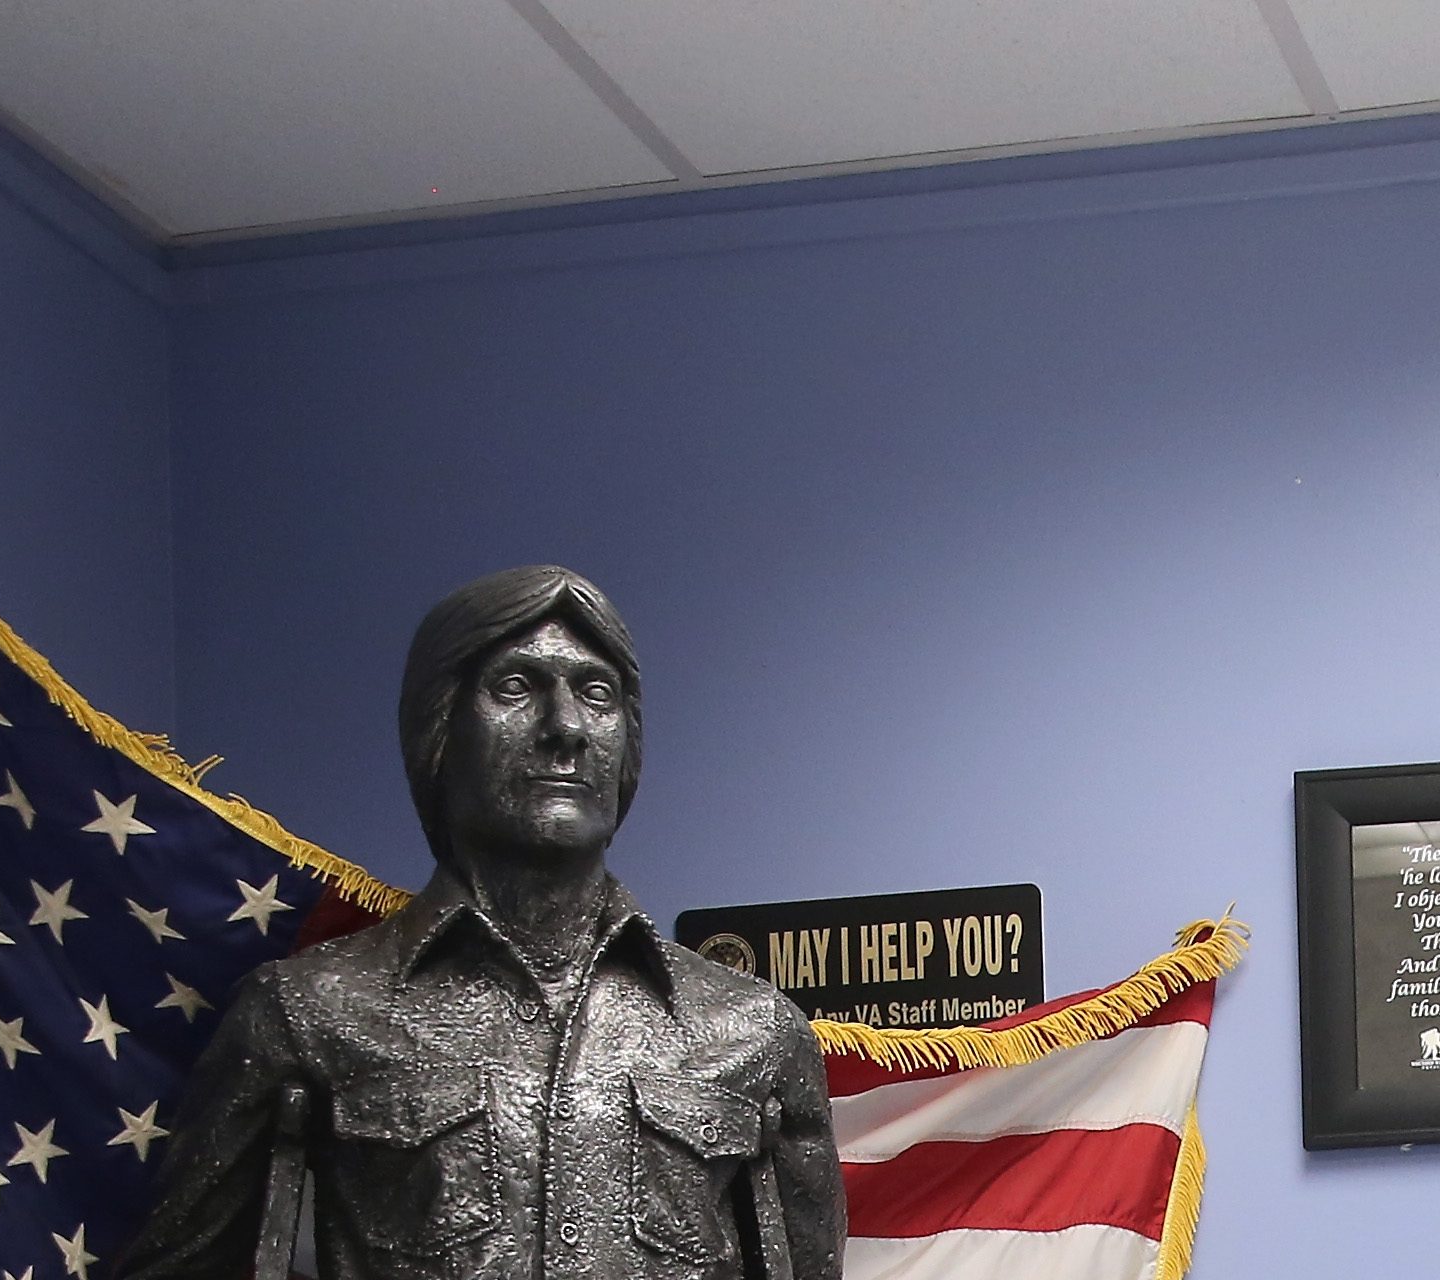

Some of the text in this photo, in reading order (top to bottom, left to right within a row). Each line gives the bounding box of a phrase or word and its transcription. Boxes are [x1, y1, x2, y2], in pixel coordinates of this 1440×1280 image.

[1393, 892, 1404, 907] I
[769, 928, 830, 990] MAY
[840, 927, 849, 985] I
[860, 921, 934, 984] HELP
[942, 913, 1023, 978] YOU?
[1396, 953, 1440, 973] And
[855, 1004, 882, 1026] VA
[888, 999, 937, 1025] Staff
[942, 995, 1026, 1021] Member
